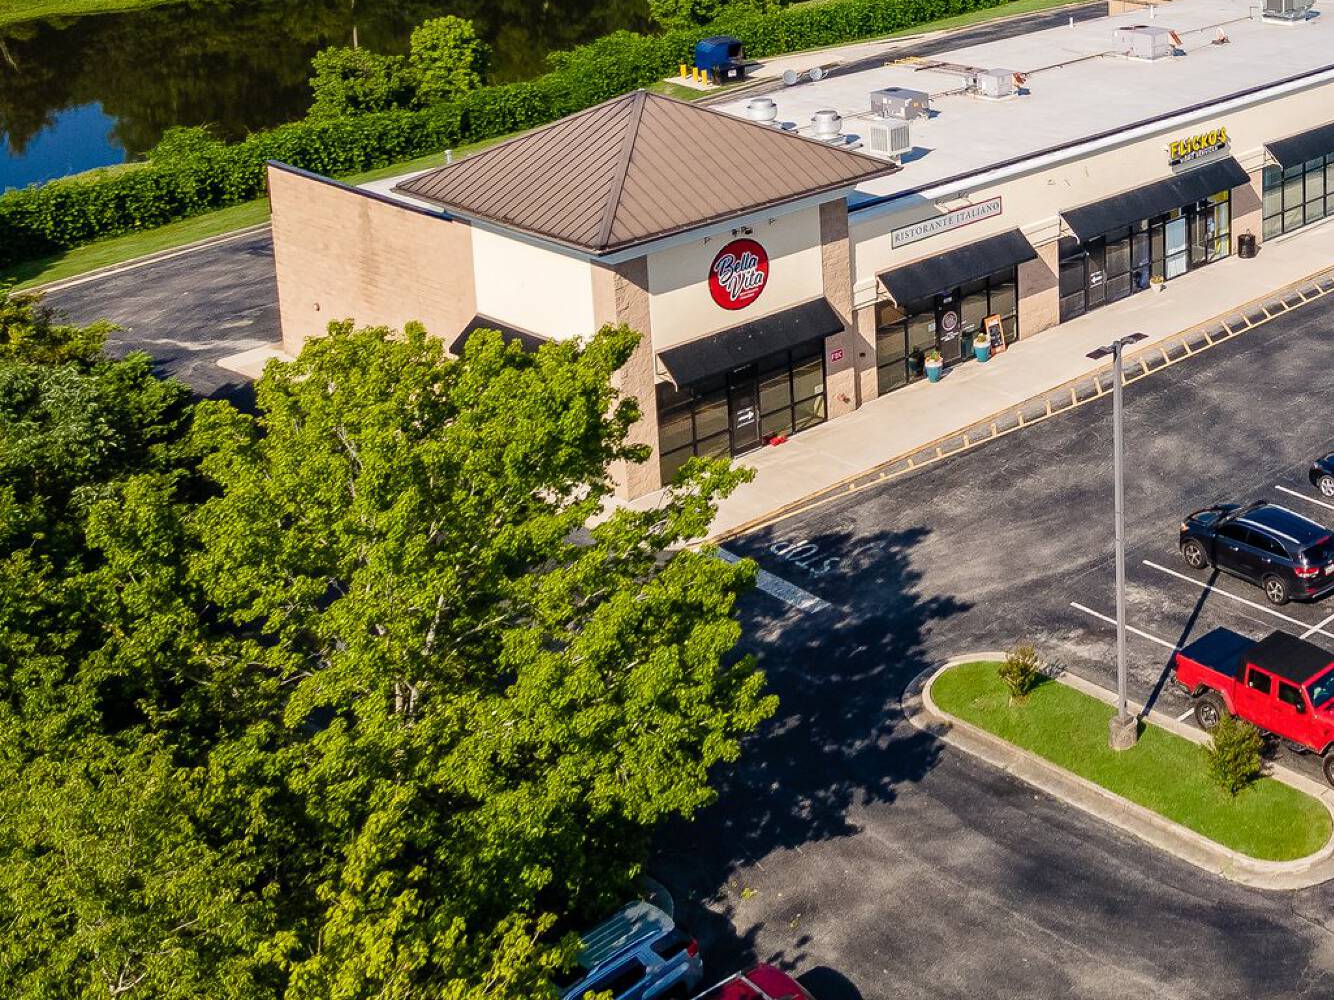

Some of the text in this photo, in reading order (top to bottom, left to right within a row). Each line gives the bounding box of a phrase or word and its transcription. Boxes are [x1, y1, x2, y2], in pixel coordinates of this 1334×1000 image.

[895, 202, 1000, 243] RISTORANTE ITALIANO
[714, 252, 758, 285] Bella
[726, 267, 764, 301] Vita
